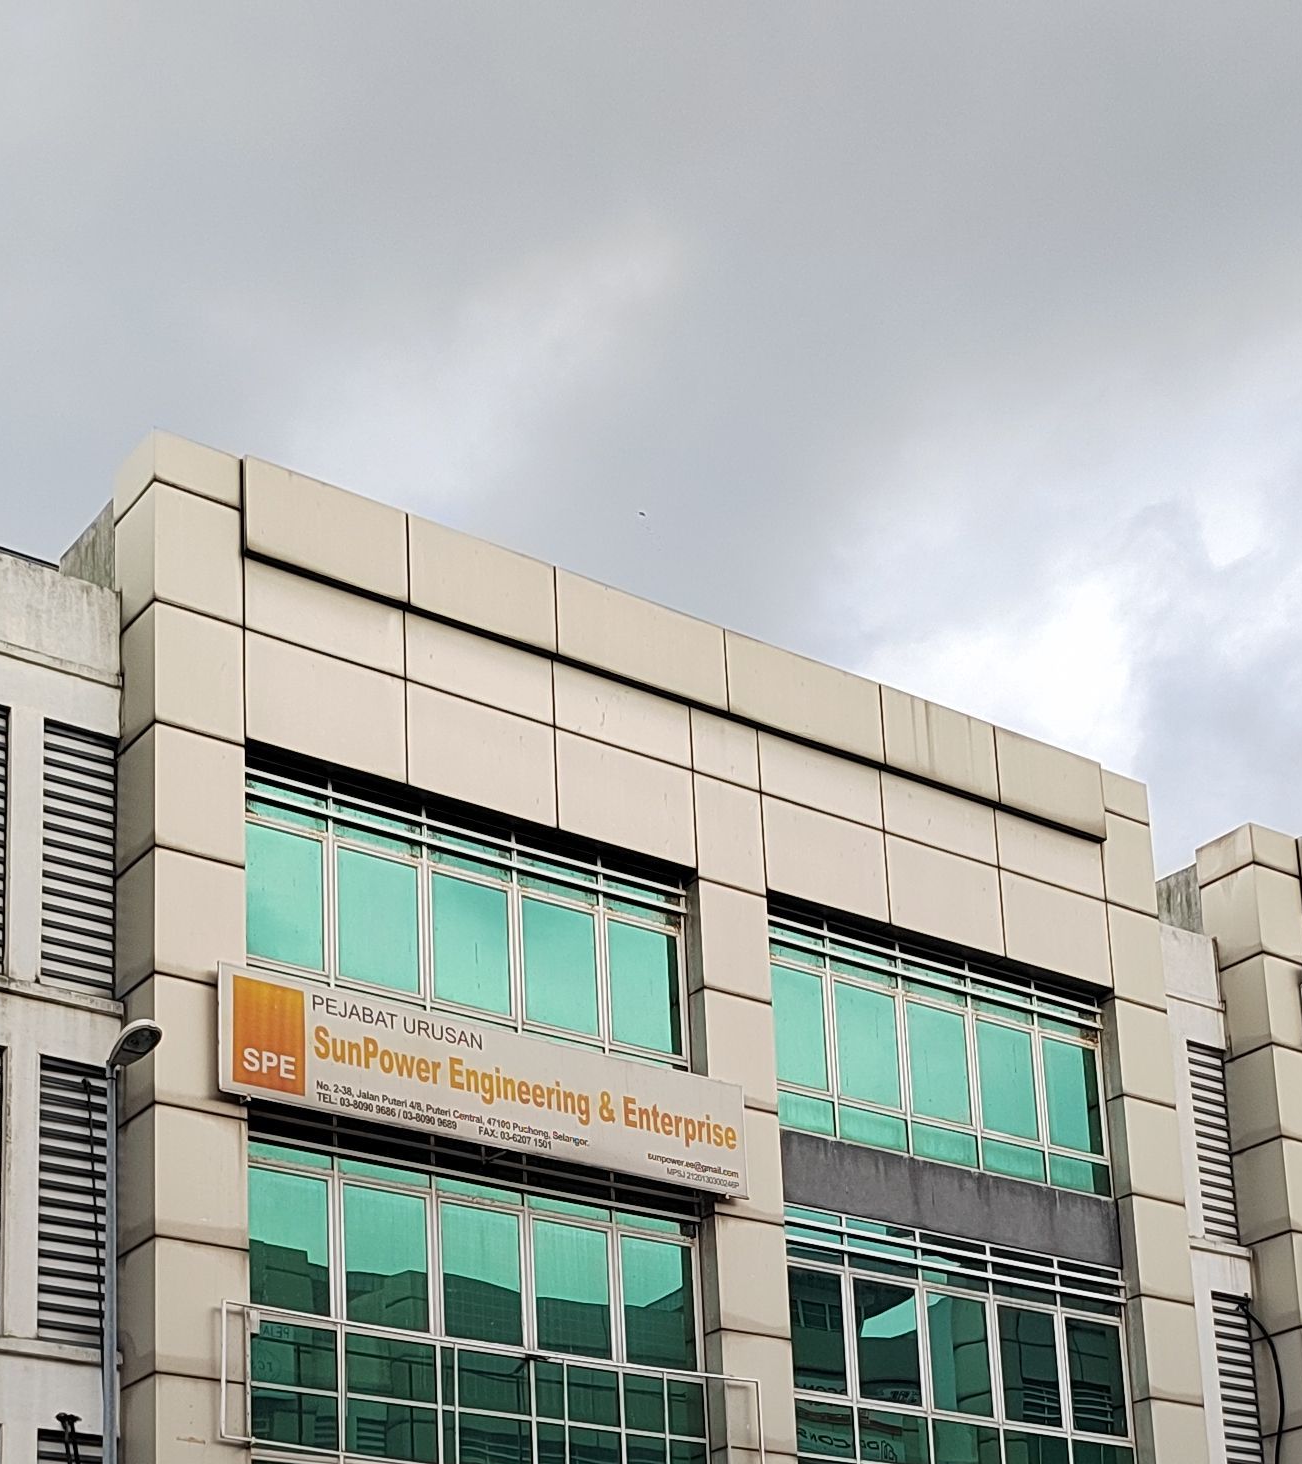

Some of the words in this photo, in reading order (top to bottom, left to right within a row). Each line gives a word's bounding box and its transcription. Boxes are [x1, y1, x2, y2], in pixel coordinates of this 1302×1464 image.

[312, 994, 398, 1031] PEJABAT
[403, 1016, 483, 1051] URUSAN
[242, 1047, 296, 1081] SPE
[313, 1025, 442, 1085] SunPower
[449, 1056, 591, 1126] Engineering
[599, 1090, 615, 1124] &
[622, 1095, 737, 1150] Enterprise
[316, 1079, 331, 1093] No.
[356, 1089, 380, 1104] Jalan
[382, 1093, 408, 1109] Puteri
[425, 1104, 451, 1118] Puteri
[487, 1116, 511, 1131] 47100
[316, 1091, 337, 1106] TEL:
[339, 1097, 374, 1114] 03-8090
[402, 1109, 435, 1126] 03-8090
[478, 1125, 499, 1139] FAX:
[500, 1130, 532, 1146] 03-6207
[533, 1137, 552, 1150] 1501
